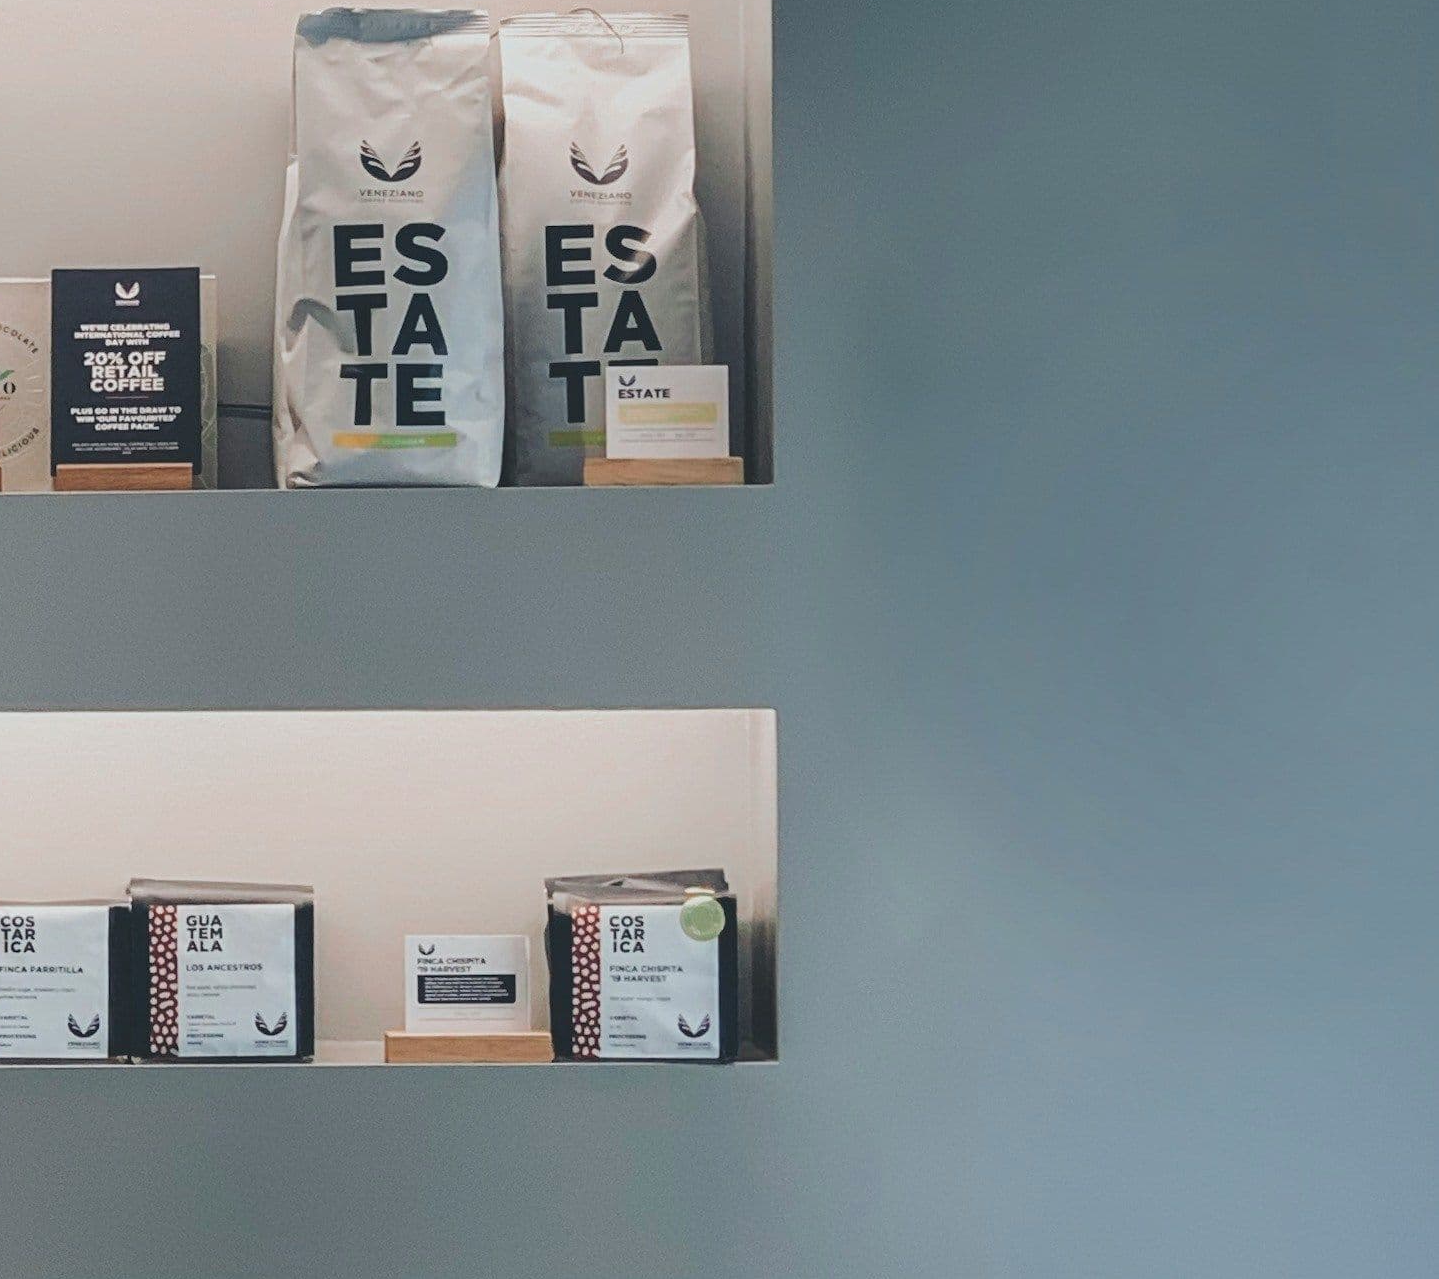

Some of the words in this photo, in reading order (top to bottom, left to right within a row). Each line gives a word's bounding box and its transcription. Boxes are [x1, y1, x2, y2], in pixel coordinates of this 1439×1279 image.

[359, 189, 424, 197] VENEZIANO
[570, 190, 632, 199] VENEZIANO
[333, 223, 448, 287] ES
[546, 224, 657, 287] ES
[336, 293, 448, 356] TA
[547, 291, 663, 355] TA
[84, 352, 124, 366] 20%
[128, 351, 166, 365] OFF
[92, 366, 158, 379] RETAIL
[90, 378, 164, 392] COFFEE
[549, 359, 658, 423] T
[340, 363, 446, 426] TE
[618, 389, 670, 399] ESTATE
[70, 407, 93, 415] PLUS
[168, 406, 182, 414] TO
[0, 916, 35, 927] COS
[187, 915, 222, 927] GUA
[610, 916, 644, 927] COS
[1, 929, 35, 940] TAR
[187, 928, 222, 939] TEM
[611, 929, 645, 940] TAR
[4, 941, 35, 953] ICA
[187, 940, 222, 952] ALA
[613, 941, 644, 953] ICA
